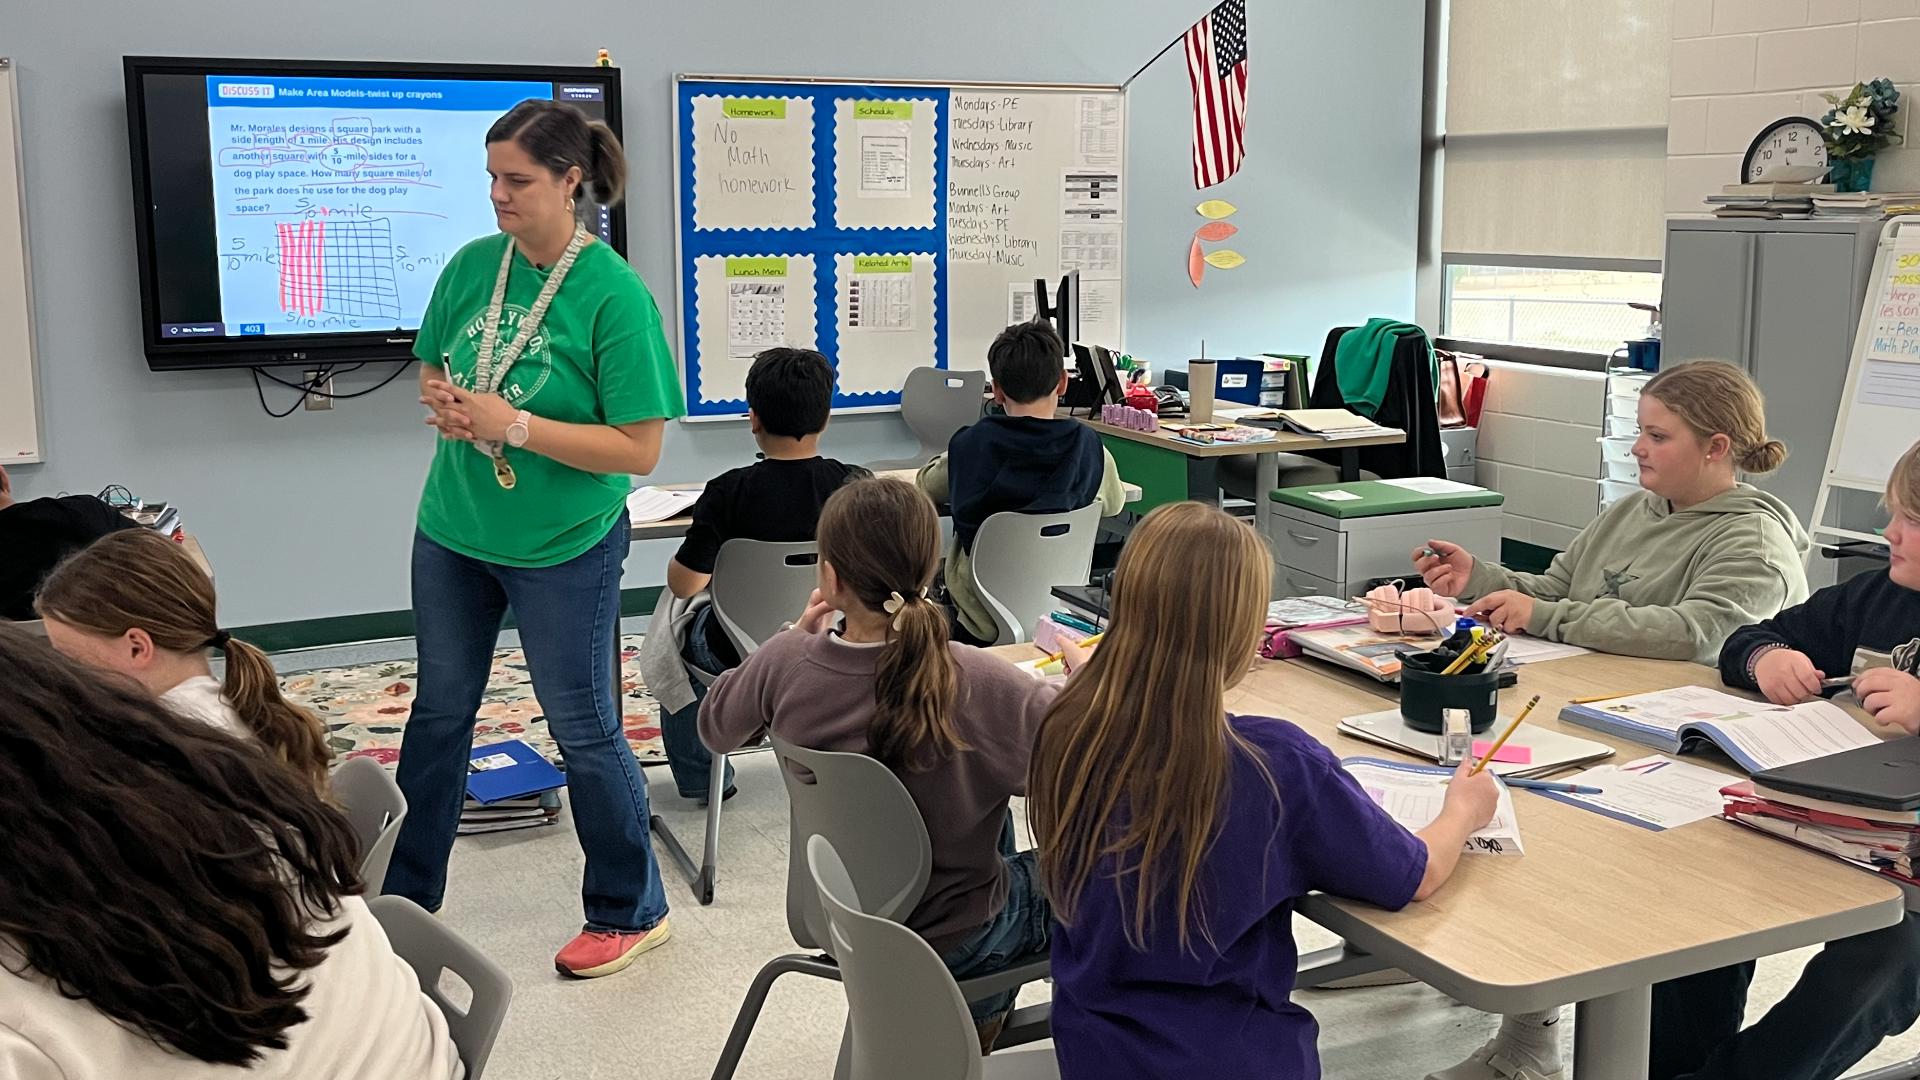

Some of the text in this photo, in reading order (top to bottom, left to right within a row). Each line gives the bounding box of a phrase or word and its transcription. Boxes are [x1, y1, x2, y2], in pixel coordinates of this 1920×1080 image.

[222, 85, 271, 96] DISCUSS IT
[278, 88, 443, 100] Make Area Models-twist up crayons
[858, 107, 894, 116] Schedule
[954, 96, 997, 114] Mondays
[1002, 97, 1020, 110] PE
[729, 108, 774, 117] Homework
[231, 123, 246, 134] Mr.
[248, 123, 286, 134] Morales
[289, 123, 327, 136] designs
[337, 125, 370, 136] square
[371, 124, 392, 136] park
[393, 124, 413, 135] with
[415, 127, 421, 135] a
[953, 117, 995, 133] Tuesdays
[999, 117, 1033, 134] Library
[714, 121, 738, 144] No
[1788, 131, 1798, 142] 12
[231, 134, 252, 145] side
[254, 134, 285, 147] length
[288, 135, 298, 146] of
[332, 136, 349, 146] His
[350, 136, 382, 149] design
[383, 136, 424, 147] includes
[952, 138, 1033, 155] Wednesdays Music
[1773, 138, 1782, 148] 11
[727, 146, 770, 167] Math
[1762, 149, 1773, 160] 10
[1814, 145, 1821, 156] 2
[232, 151, 270, 162] another
[271, 152, 306, 164] square
[307, 151, 328, 162] with
[368, 152, 393, 162] sides
[395, 152, 410, 162] for
[410, 154, 417, 162] a
[951, 156, 990, 173] Thursdays
[998, 155, 1015, 168] Art
[233, 168, 433, 181] dog play space. How many square miles of
[1755, 166, 1763, 176] 9
[719, 172, 796, 195] homework
[234, 185, 408, 198] the park does he use for the dog play
[949, 181, 1020, 202] Bunnell's Group
[235, 202, 271, 215] space?
[328, 202, 373, 218] mile
[949, 200, 984, 216] Mondays
[991, 203, 1009, 216] Art
[949, 217, 989, 233] Tuesdays
[996, 218, 1009, 231] PE
[949, 232, 1000, 249] Wednesdays
[1004, 234, 1038, 257] Library
[859, 259, 910, 268] Related Arts
[949, 247, 991, 265] Thursday
[996, 249, 1025, 267] Music
[732, 267, 785, 277] Lunch Menu
[244, 324, 261, 333] 403
[1873, 337, 1897, 353] Math
